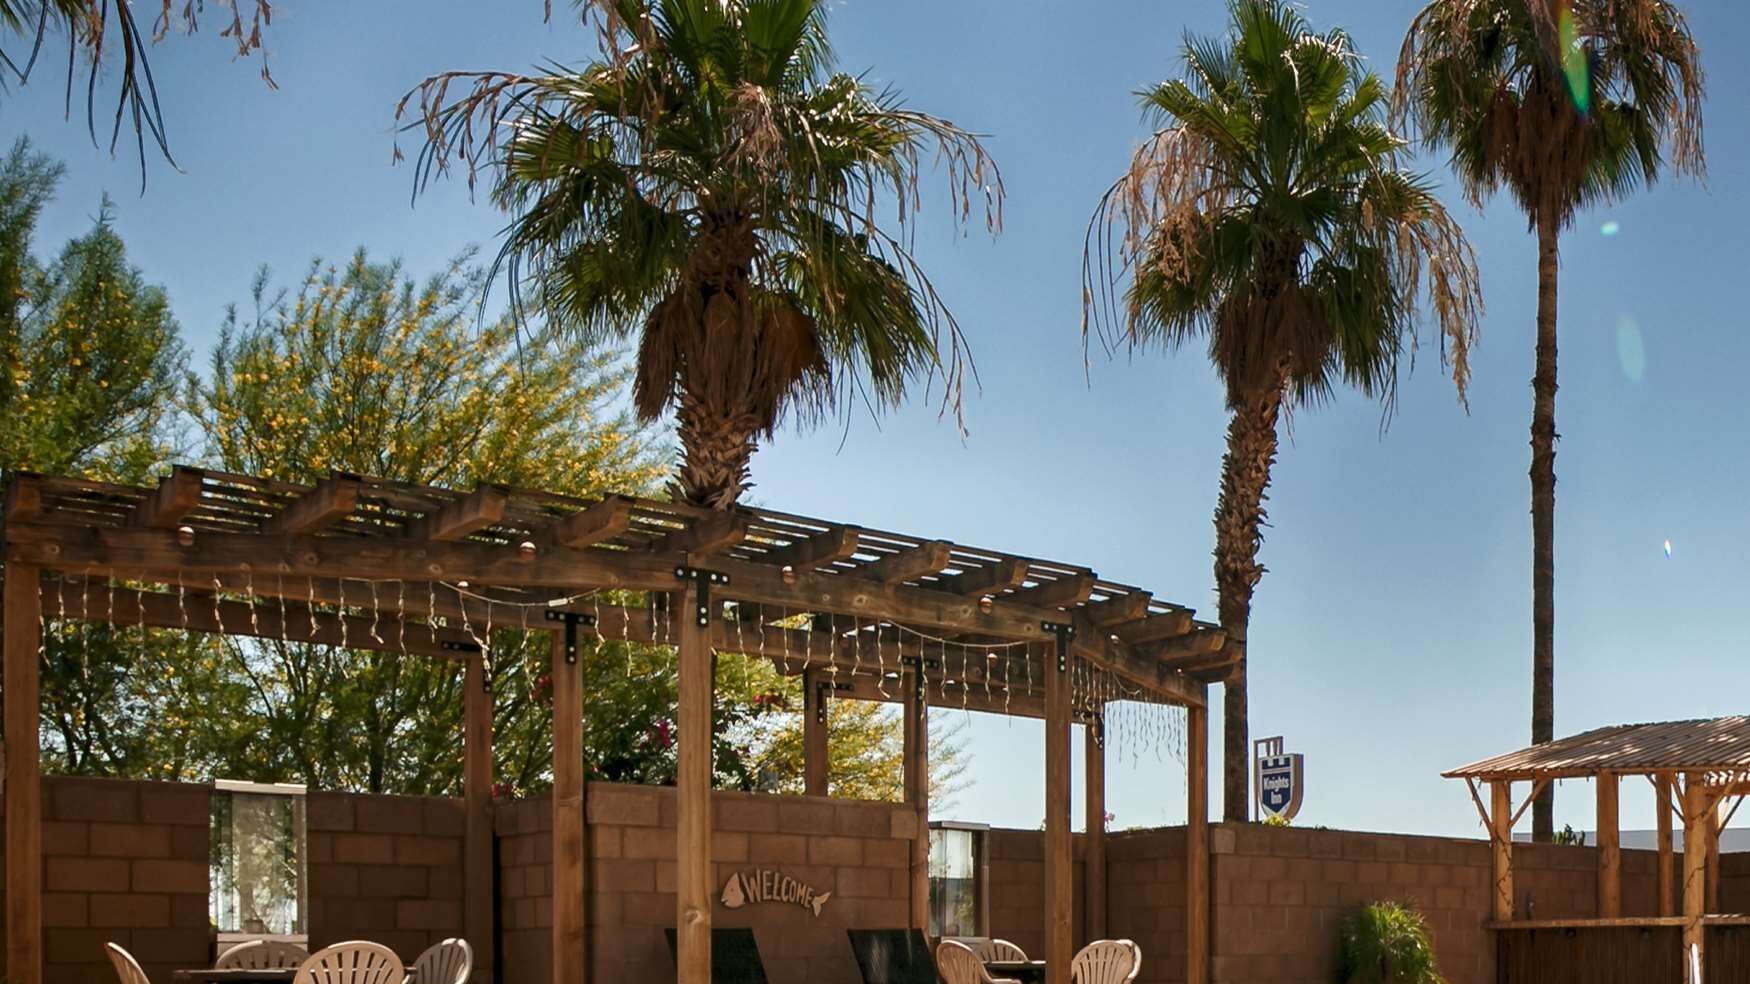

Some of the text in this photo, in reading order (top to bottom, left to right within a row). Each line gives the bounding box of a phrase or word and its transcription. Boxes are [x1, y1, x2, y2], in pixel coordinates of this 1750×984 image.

[1263, 776, 1290, 793] Knights
[1270, 790, 1282, 804] Inn
[740, 867, 815, 908] WELCOME
